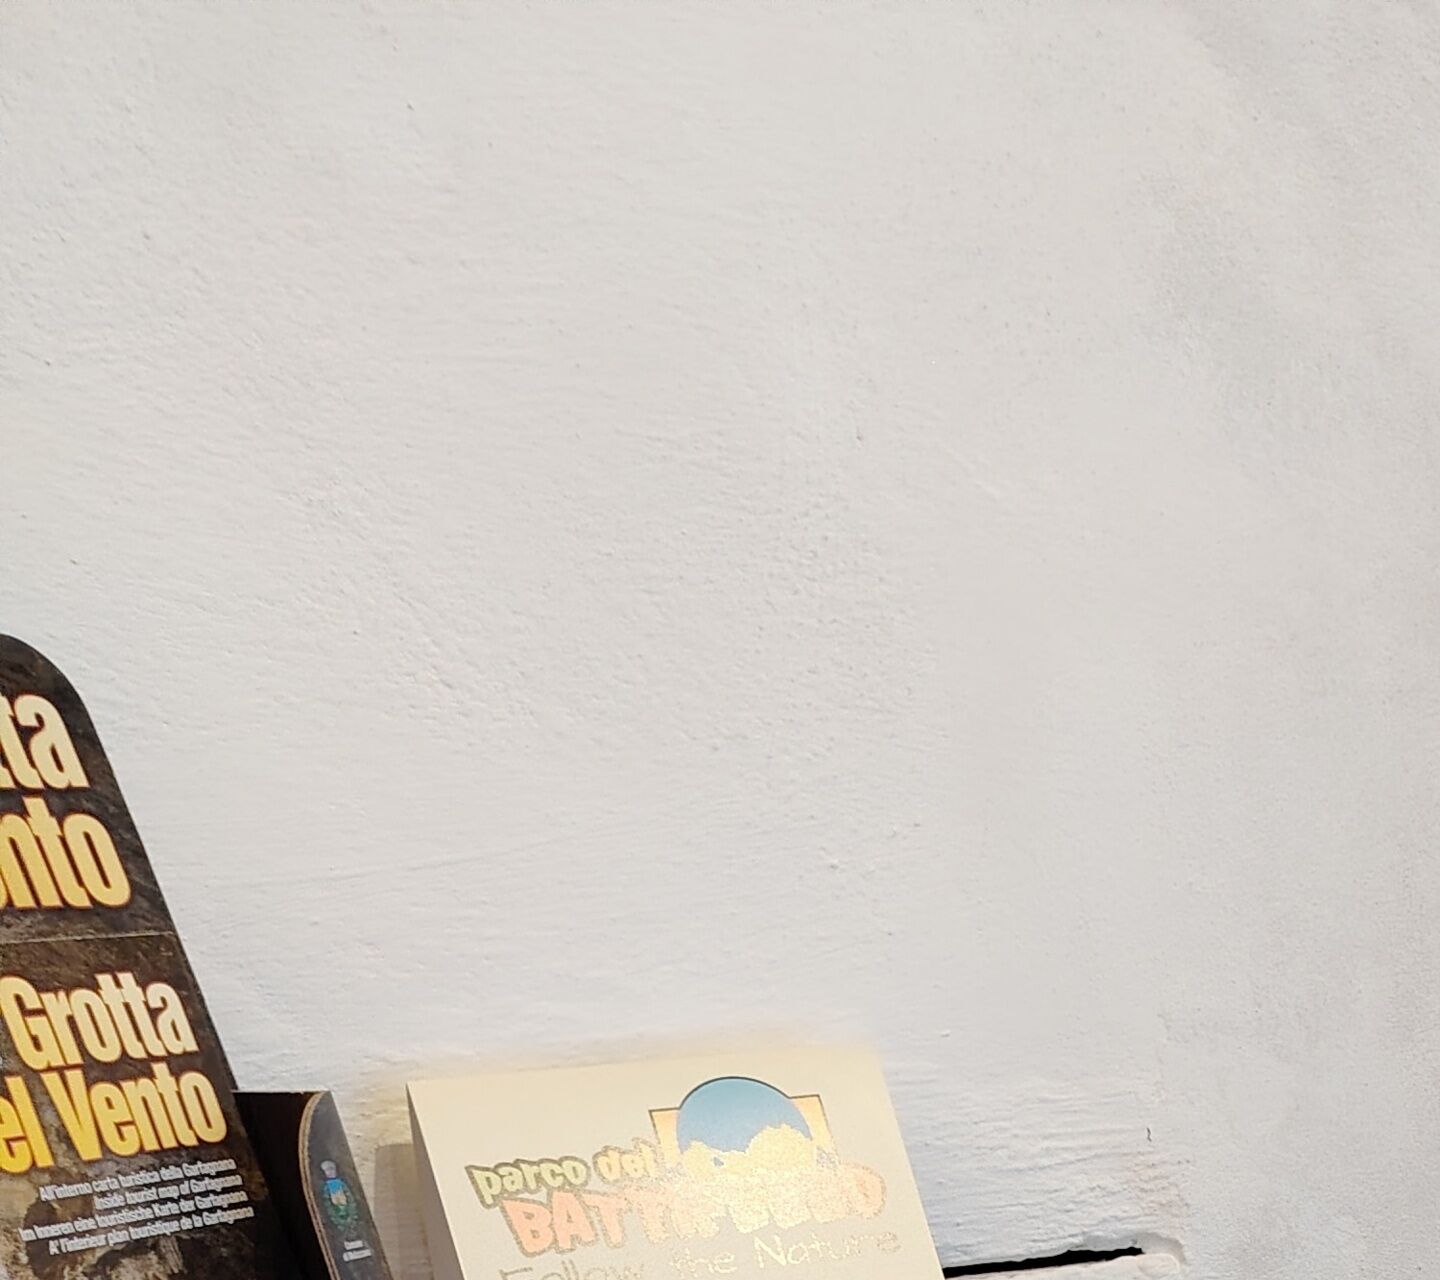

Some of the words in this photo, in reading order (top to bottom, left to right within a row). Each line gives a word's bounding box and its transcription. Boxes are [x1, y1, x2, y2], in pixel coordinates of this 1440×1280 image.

[1, 972, 198, 1072] Grotta
[0, 1073, 53, 1174] el
[54, 1061, 229, 1164] Vento
[157, 1183, 179, 1200] map
[465, 1150, 589, 1208] parco
